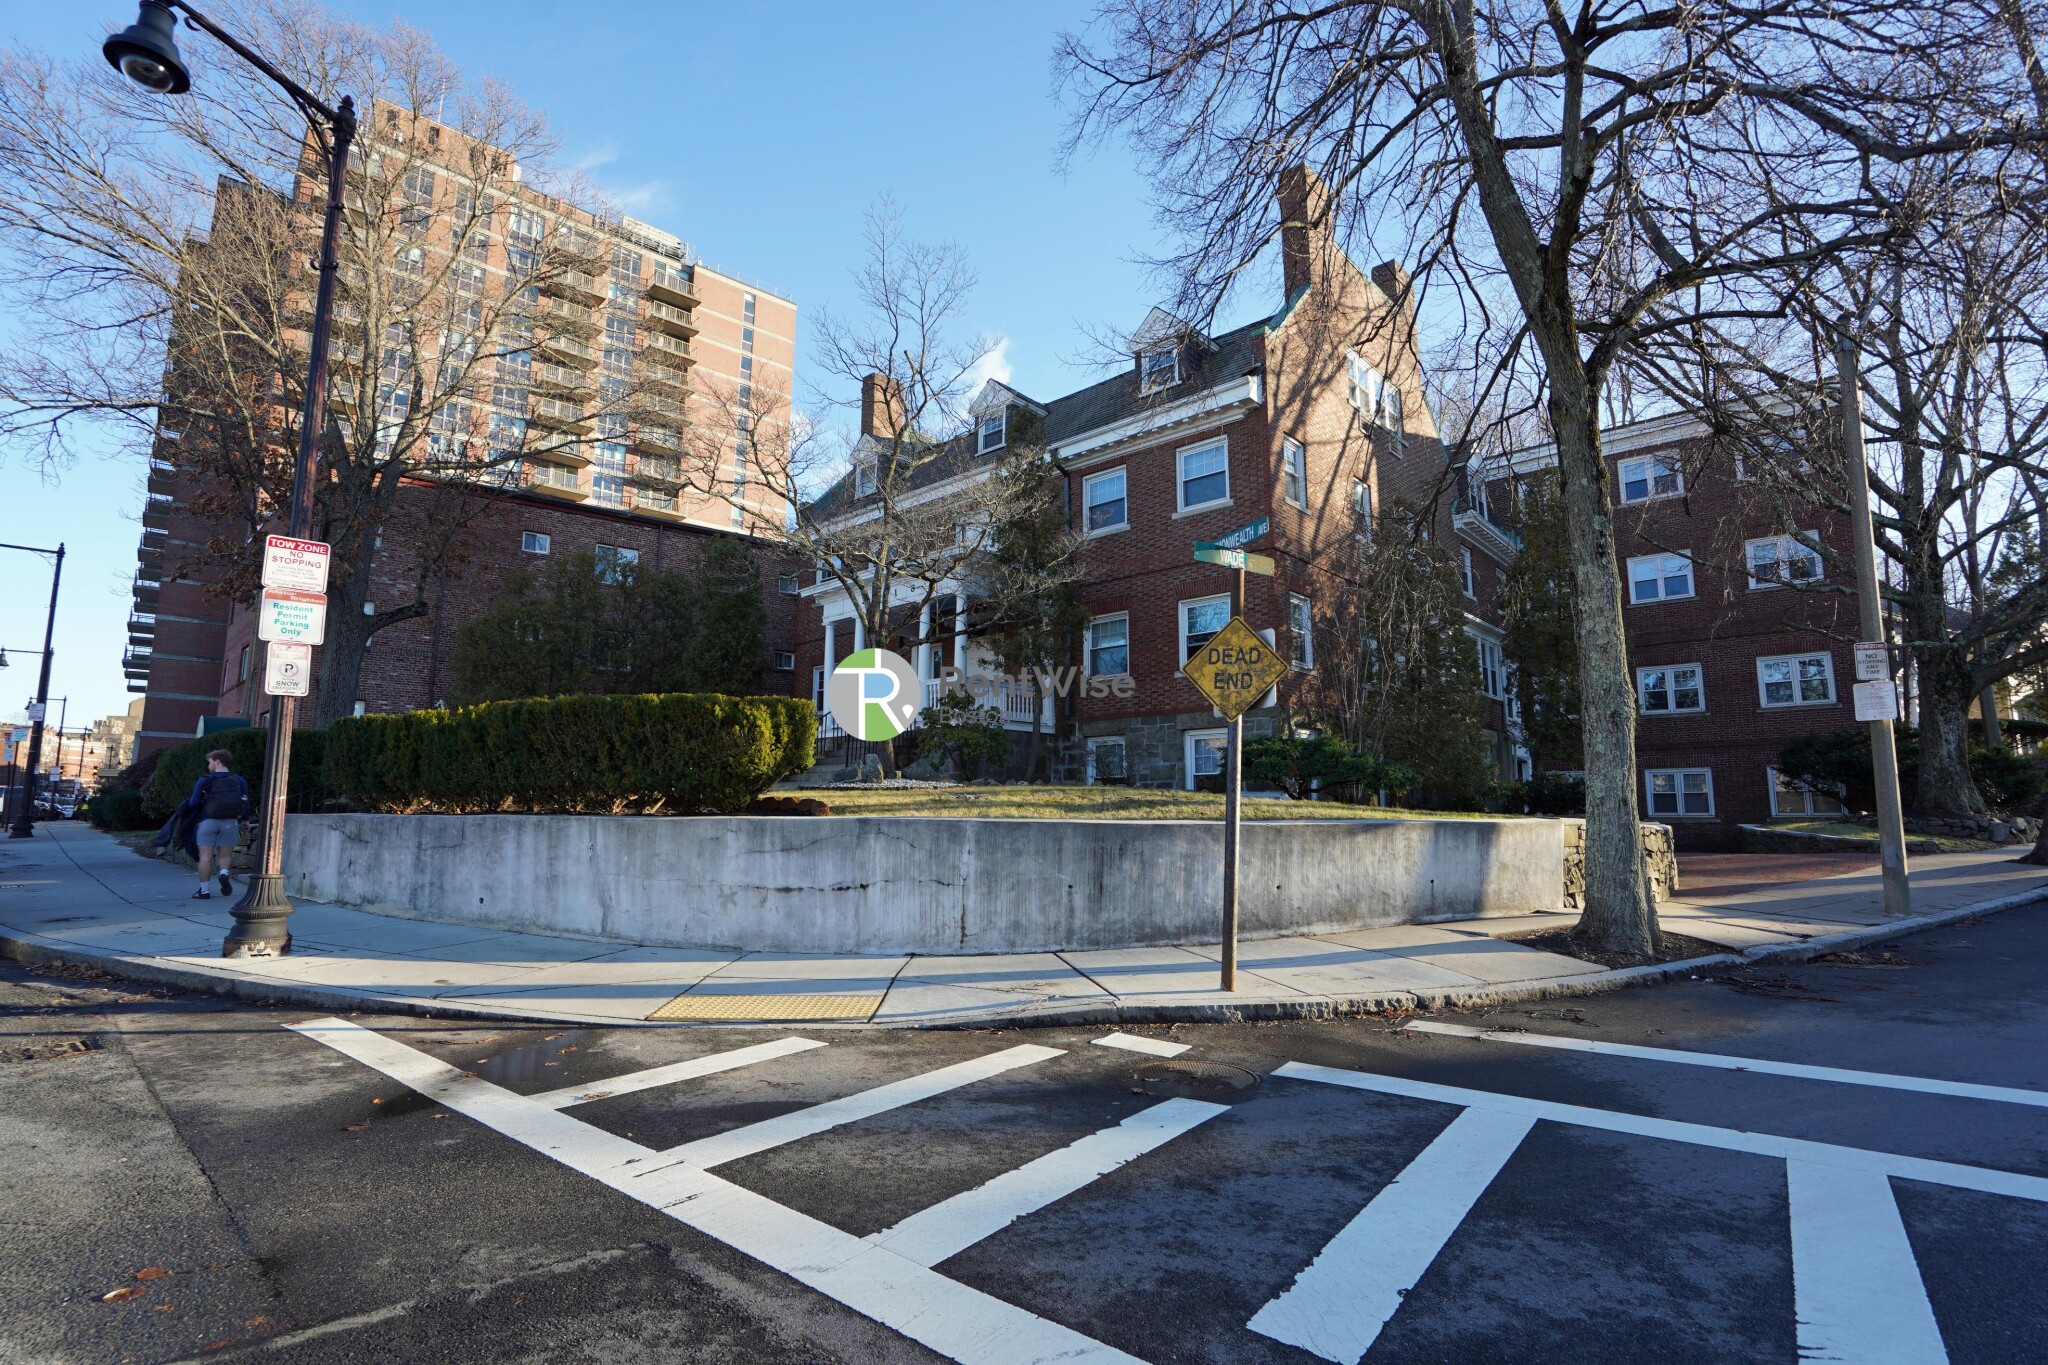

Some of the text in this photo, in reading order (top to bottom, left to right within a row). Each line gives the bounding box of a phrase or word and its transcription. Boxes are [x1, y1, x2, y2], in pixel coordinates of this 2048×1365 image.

[1257, 522, 1267, 536] AVE
[270, 538, 328, 554] TOW ZONE
[290, 550, 304, 559] NO
[1220, 549, 1245, 568] WADE
[272, 555, 322, 569] STOPPING
[290, 595, 325, 604] Brighton
[273, 602, 313, 613] Resident
[277, 611, 308, 620] Permit
[274, 618, 309, 629] Parking
[281, 627, 301, 636] Only
[1208, 645, 1261, 665] DEAD
[1213, 671, 1253, 690] END
